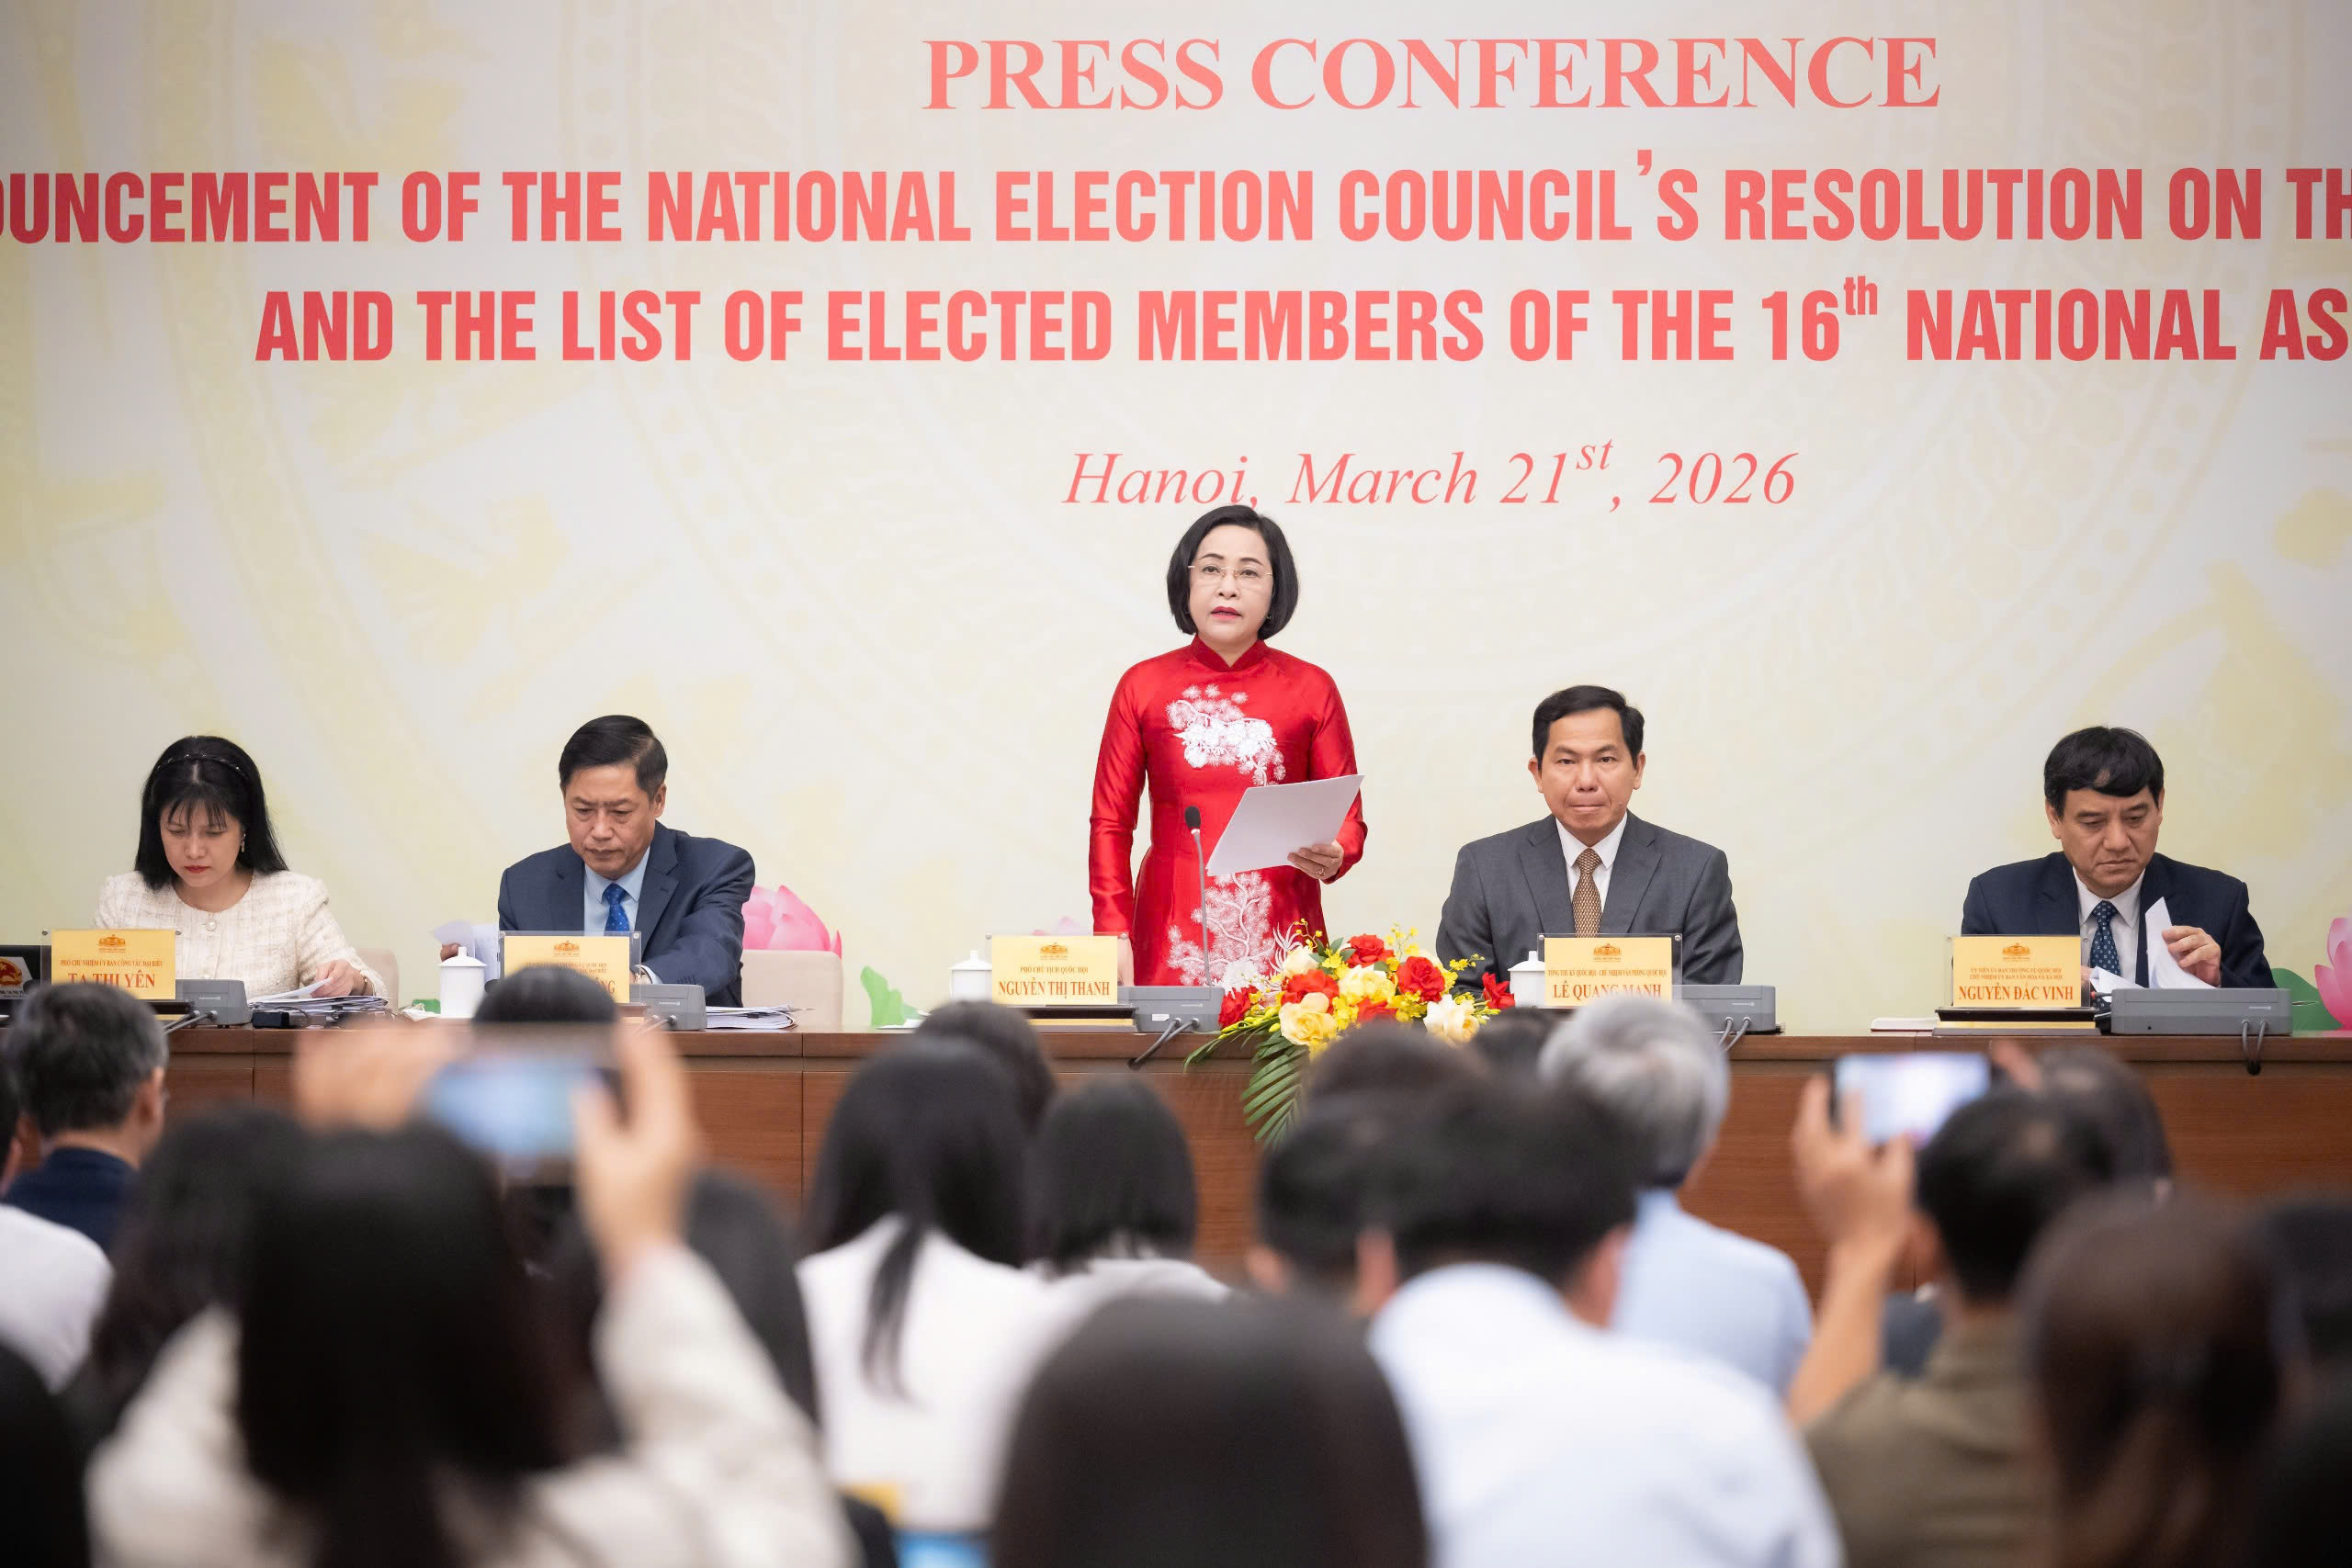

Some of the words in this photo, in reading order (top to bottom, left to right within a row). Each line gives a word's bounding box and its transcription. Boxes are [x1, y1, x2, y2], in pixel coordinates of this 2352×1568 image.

[922, 38, 1224, 110] PRESS
[1250, 36, 1940, 109] CONFERENCE
[0, 170, 379, 244] UNCEMENT
[401, 170, 481, 243] OF
[502, 170, 622, 243] THE
[648, 169, 971, 243] NATIONAL
[995, 169, 1314, 243] ELECTION
[1724, 167, 2143, 242] RESOLUTION
[2168, 166, 2263, 241] ON
[254, 289, 394, 362] AND
[415, 289, 537, 362] THE
[561, 289, 701, 363] LIST
[723, 289, 803, 363] OF
[828, 289, 1113, 362] ELECTED
[1138, 288, 1485, 363] MEMBERS
[1510, 288, 1590, 363] OF
[1611, 288, 1736, 362] THE
[1761, 275, 1879, 363] 16th
[1906, 288, 2238, 362] NATIONAL
[2258, 288, 2349, 362] AS
[1061, 453, 1258, 510] Hanoi,
[1286, 451, 1478, 504] March
[1647, 451, 1800, 505] 2026
[125, 969, 155, 988] YÊN
[999, 977, 1046, 996] NGUYỄN
[1048, 981, 1068, 998] THỊ
[1070, 981, 1110, 996] THANH
[1554, 980, 1569, 998] LÊ
[1959, 982, 2010, 1000] NGUYỄN
[2013, 982, 2040, 1000] ĐẮC
[2043, 986, 2074, 1000] VINH
